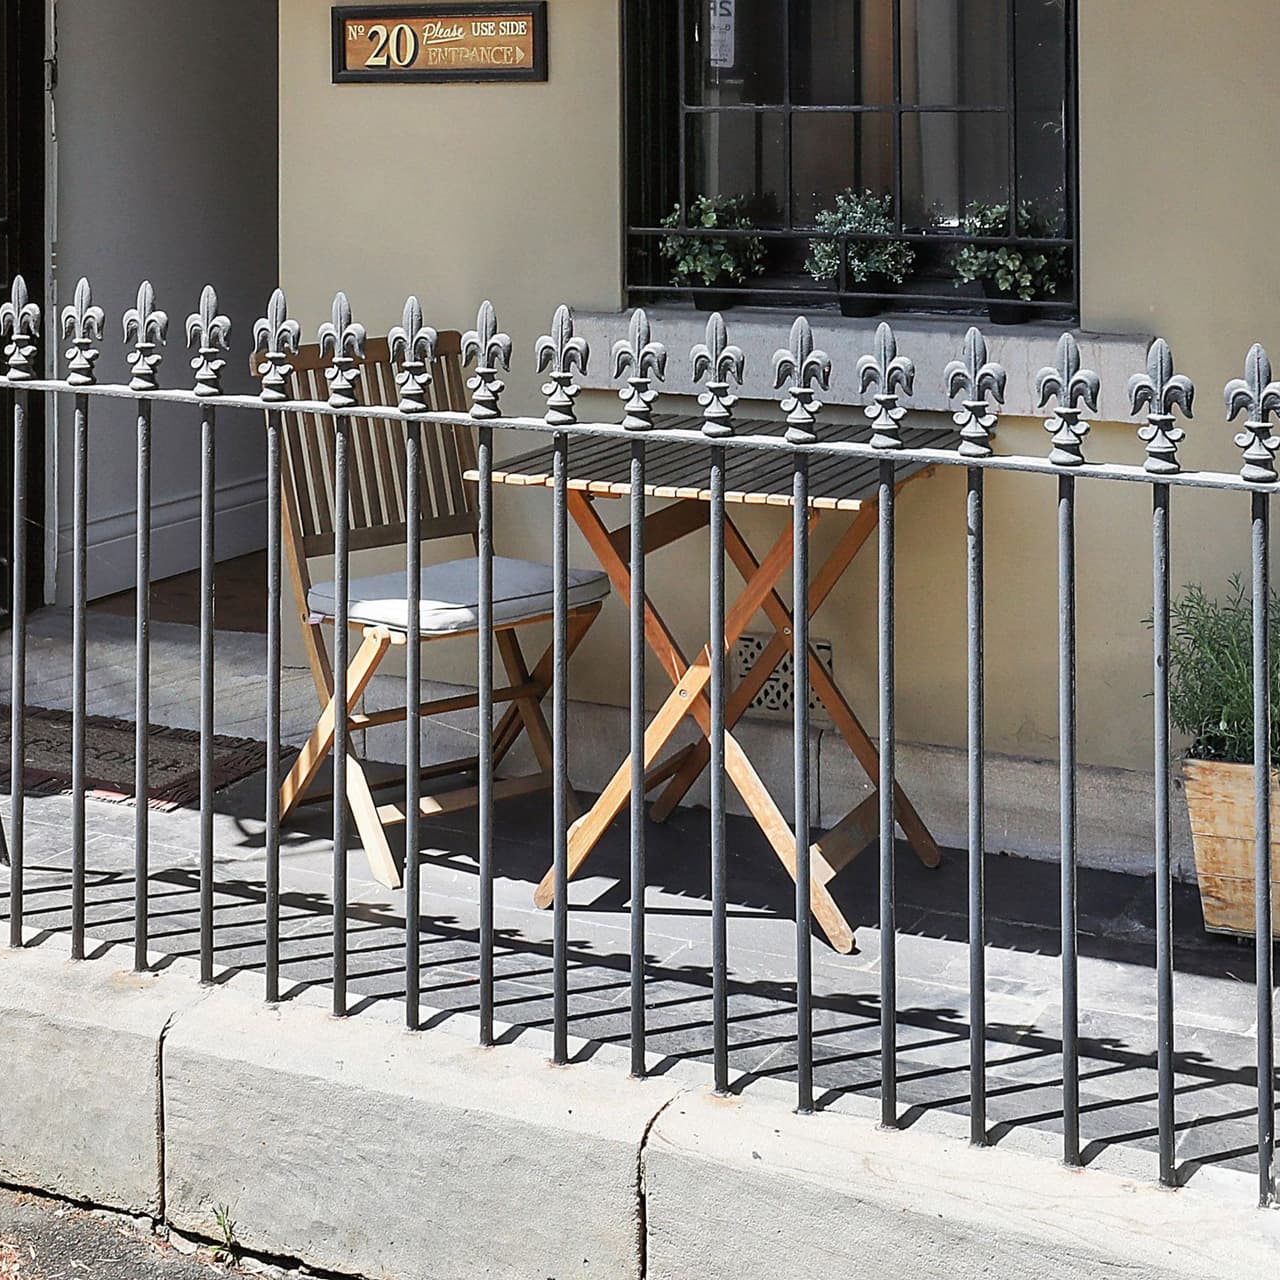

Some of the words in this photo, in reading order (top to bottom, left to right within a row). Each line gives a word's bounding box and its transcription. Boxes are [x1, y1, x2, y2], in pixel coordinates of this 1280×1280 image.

[423, 22, 465, 45] Please
[471, 22, 496, 36] USE
[499, 21, 527, 36] SIDE
[365, 24, 419, 68] 20
[428, 46, 514, 65] ENTRANCE
